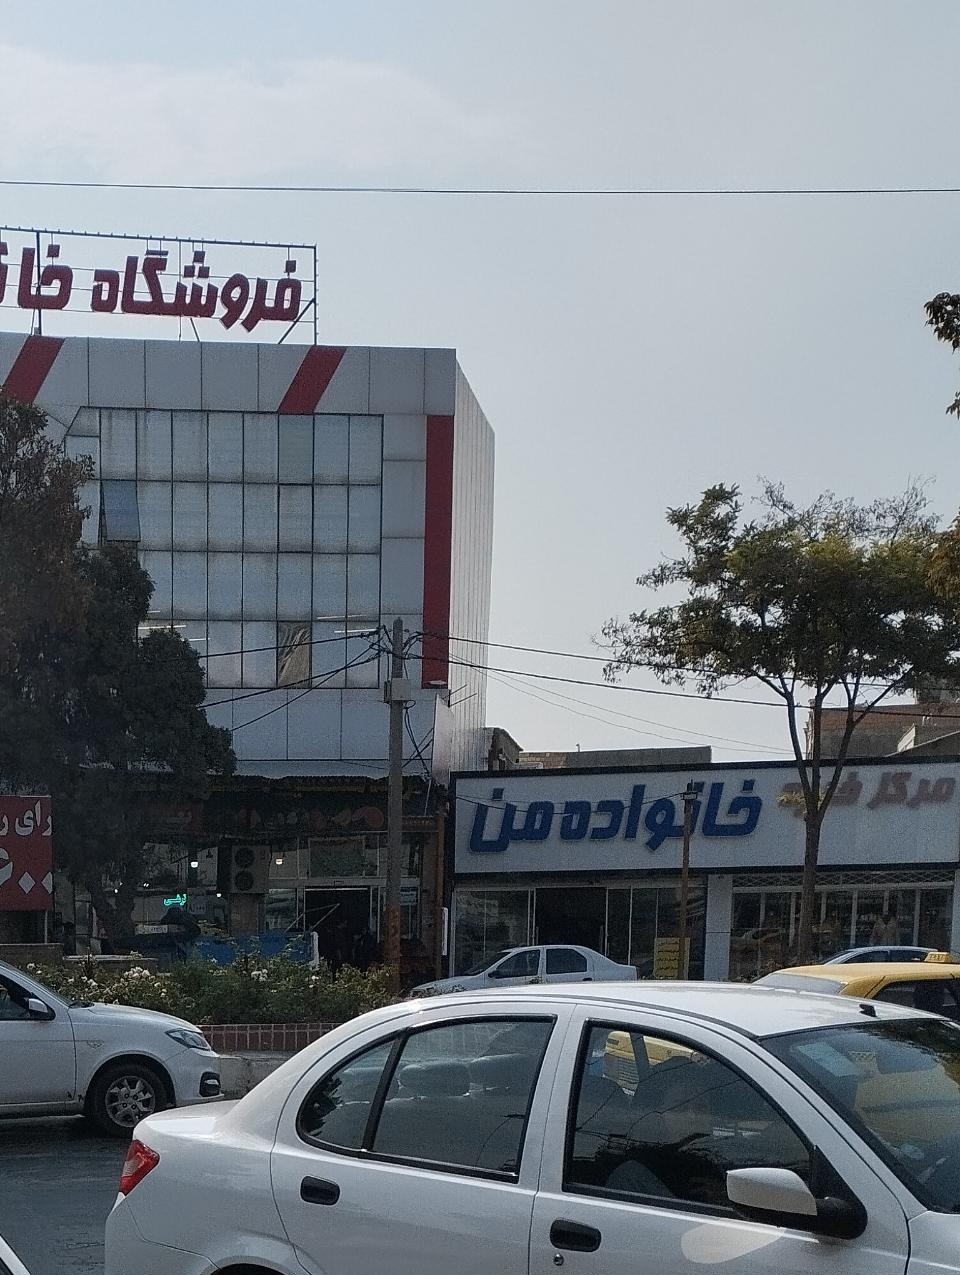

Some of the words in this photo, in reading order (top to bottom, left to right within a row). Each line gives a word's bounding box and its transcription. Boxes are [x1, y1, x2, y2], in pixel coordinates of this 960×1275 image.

[91, 249, 302, 331] فروشگاه
[15, 800, 52, 836] رای
[469, 787, 555, 852] من
[560, 779, 762, 852] خانواده
